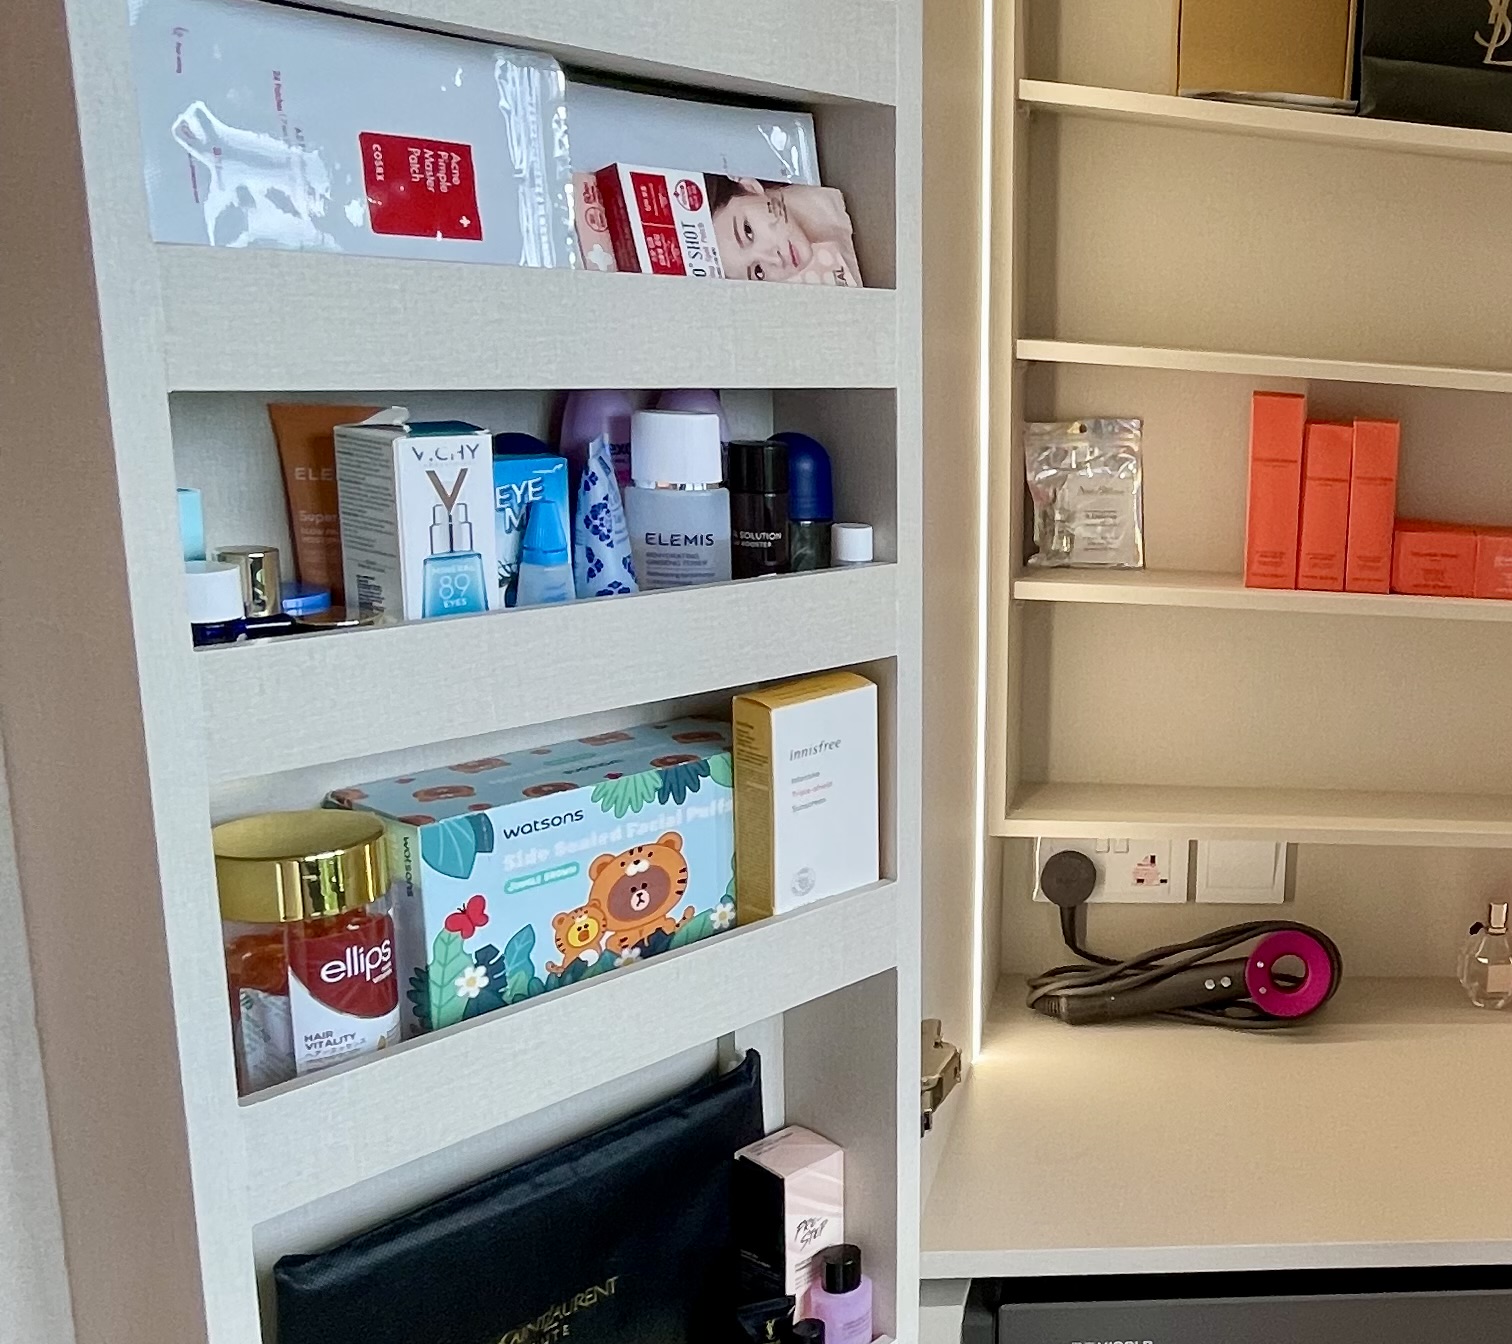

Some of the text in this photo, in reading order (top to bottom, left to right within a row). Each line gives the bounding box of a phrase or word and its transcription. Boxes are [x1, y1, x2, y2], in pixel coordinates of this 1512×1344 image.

[407, 147, 425, 182] Patch
[423, 148, 436, 193] Master
[437, 150, 452, 193] Pimple
[450, 152, 462, 186] Acne
[680, 220, 704, 260] SHOT
[495, 476, 544, 512] EYE
[645, 532, 715, 548] ELEMIS
[740, 531, 782, 541] SOLUTION
[438, 573, 472, 600] 89
[442, 597, 468, 609] EYES
[789, 739, 842, 762] innisfree
[503, 809, 585, 840] watsons
[553, 830, 622, 856] Sealed
[625, 812, 684, 843] Facial
[320, 939, 392, 983] ellips
[304, 1030, 334, 1043] HAIR
[305, 1032, 357, 1051] VITALITY
